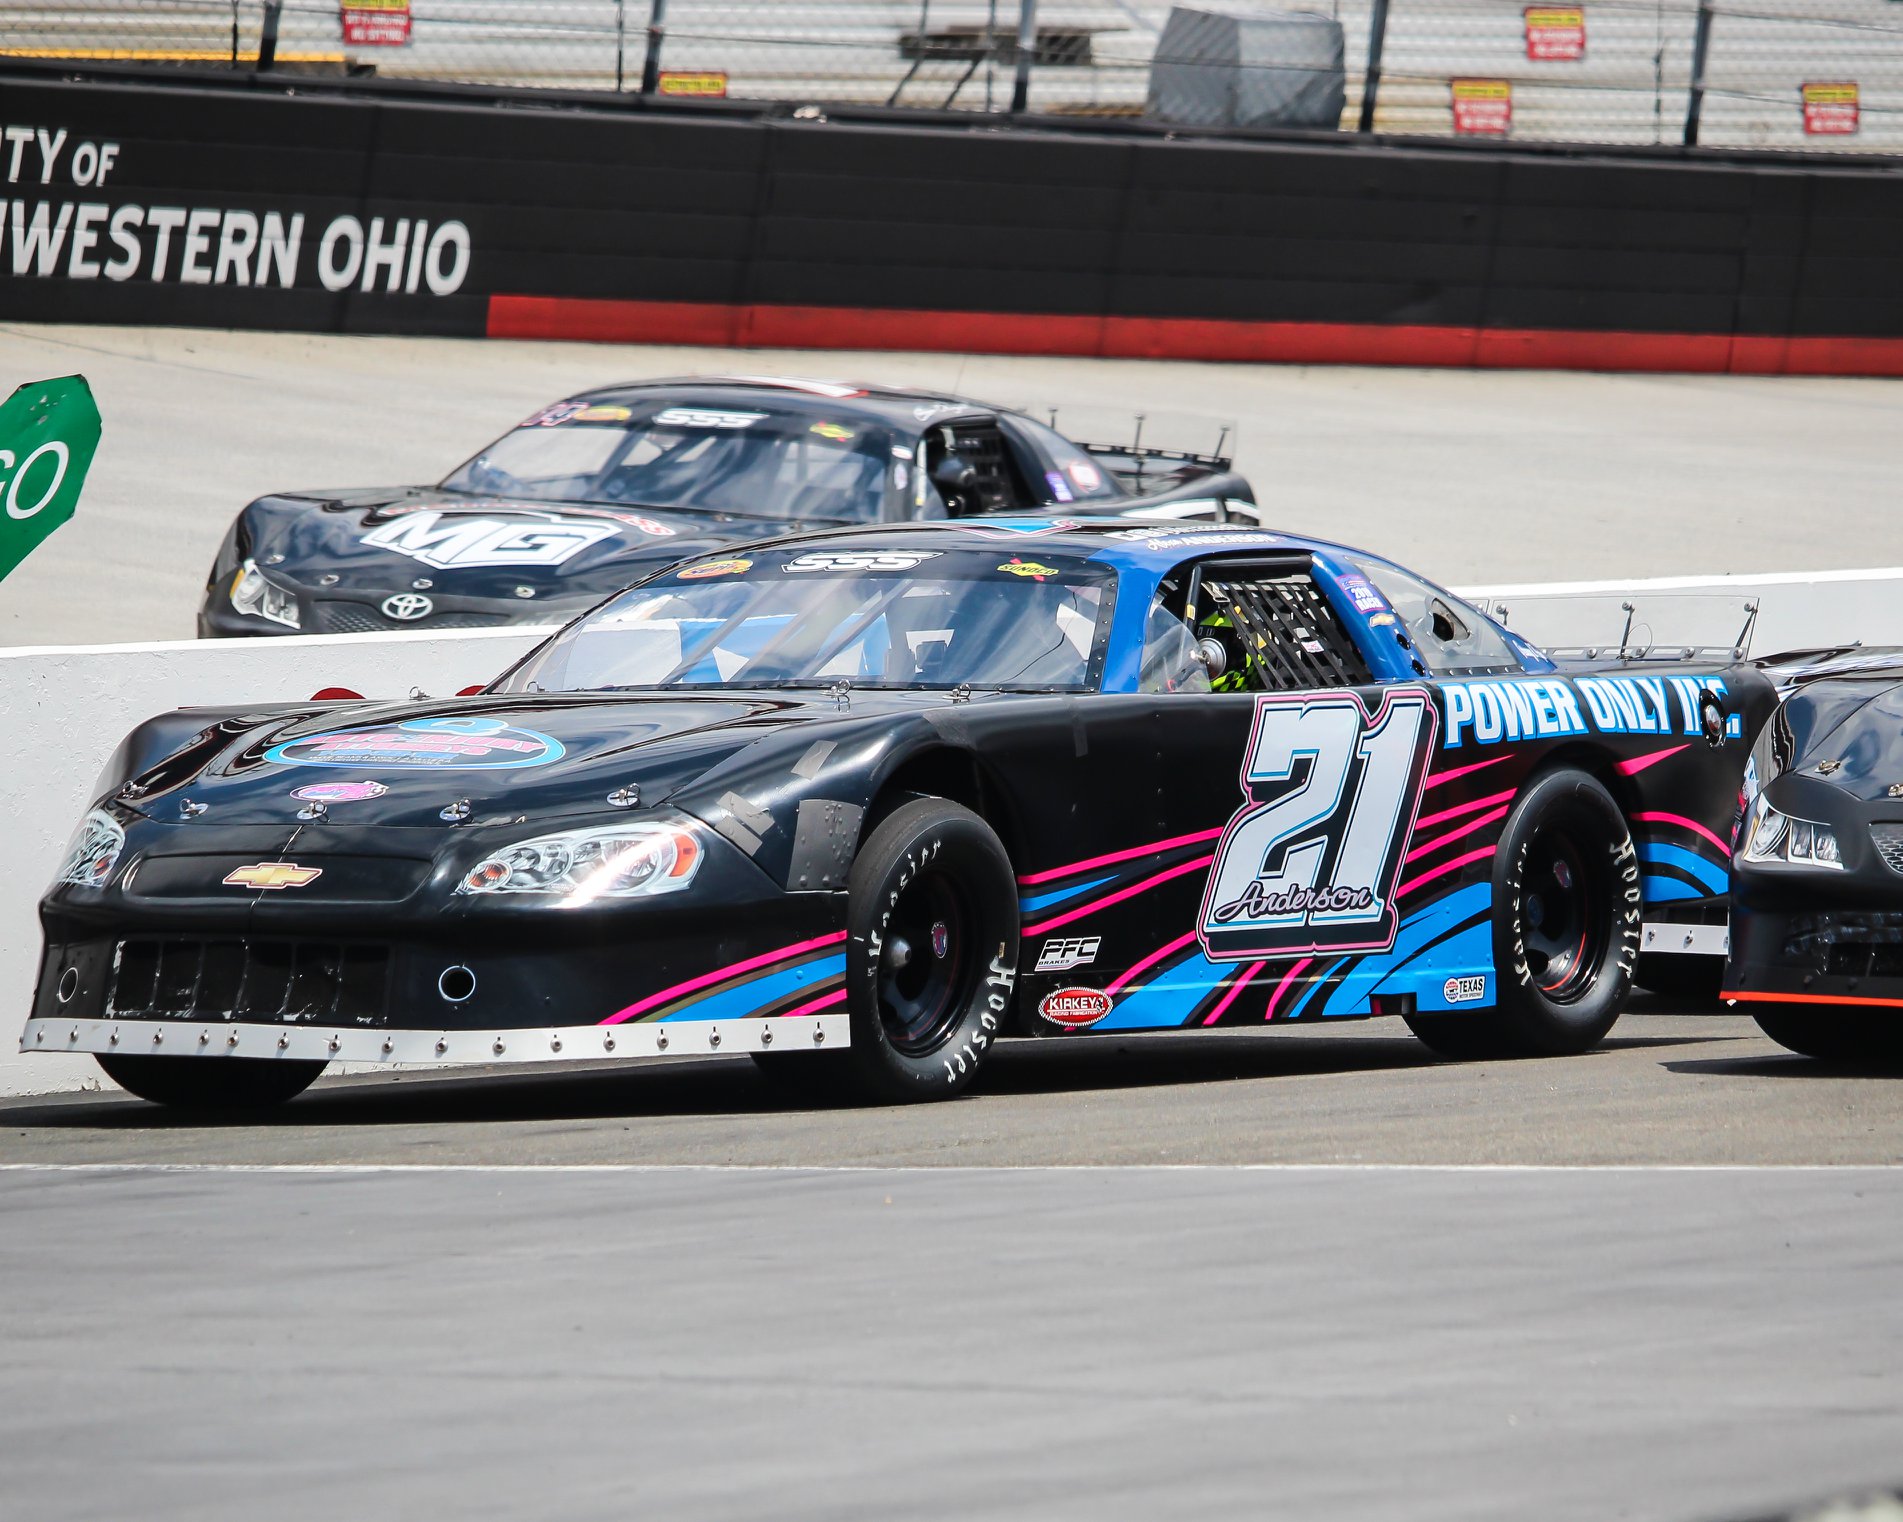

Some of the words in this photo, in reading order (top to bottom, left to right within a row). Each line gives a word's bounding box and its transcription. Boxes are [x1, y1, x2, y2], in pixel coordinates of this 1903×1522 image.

[0, 126, 68, 184] TY
[71, 141, 120, 187] OF
[0, 200, 305, 289] WESTERN
[318, 215, 471, 296] OHIO
[364, 510, 616, 567] MG
[781, 551, 946, 574] SSS
[1000, 563, 1057, 575] SUNOCO
[1443, 681, 1588, 748] POWER
[1573, 676, 1672, 735] ONLY
[1201, 692, 1430, 936] 21
[1215, 881, 1373, 922] Anderson
[1040, 938, 1100, 960] PFC
[1049, 997, 1097, 1010] KIRKEY
[1459, 978, 1483, 993] TEXAS
